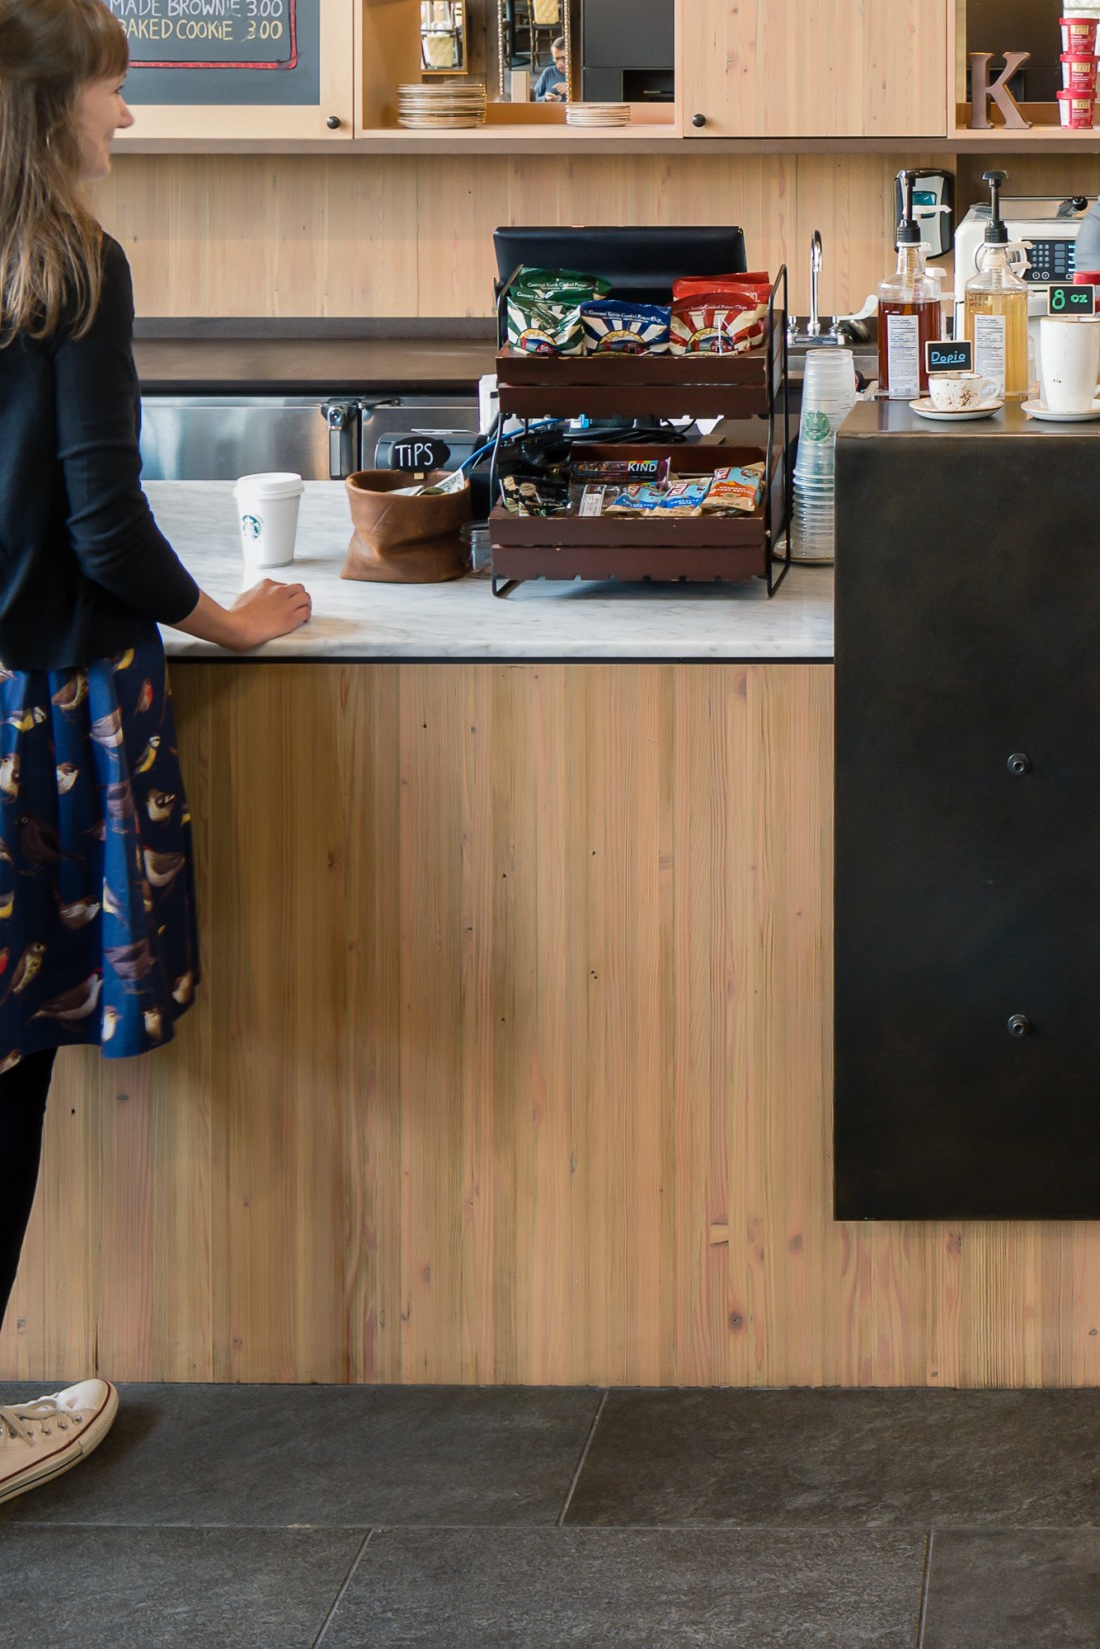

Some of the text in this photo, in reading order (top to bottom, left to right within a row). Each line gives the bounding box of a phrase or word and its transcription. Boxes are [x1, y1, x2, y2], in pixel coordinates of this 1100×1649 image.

[1051, 288, 1066, 310] 8
[931, 350, 966, 364] Dopio
[627, 462, 657, 472] KIND
